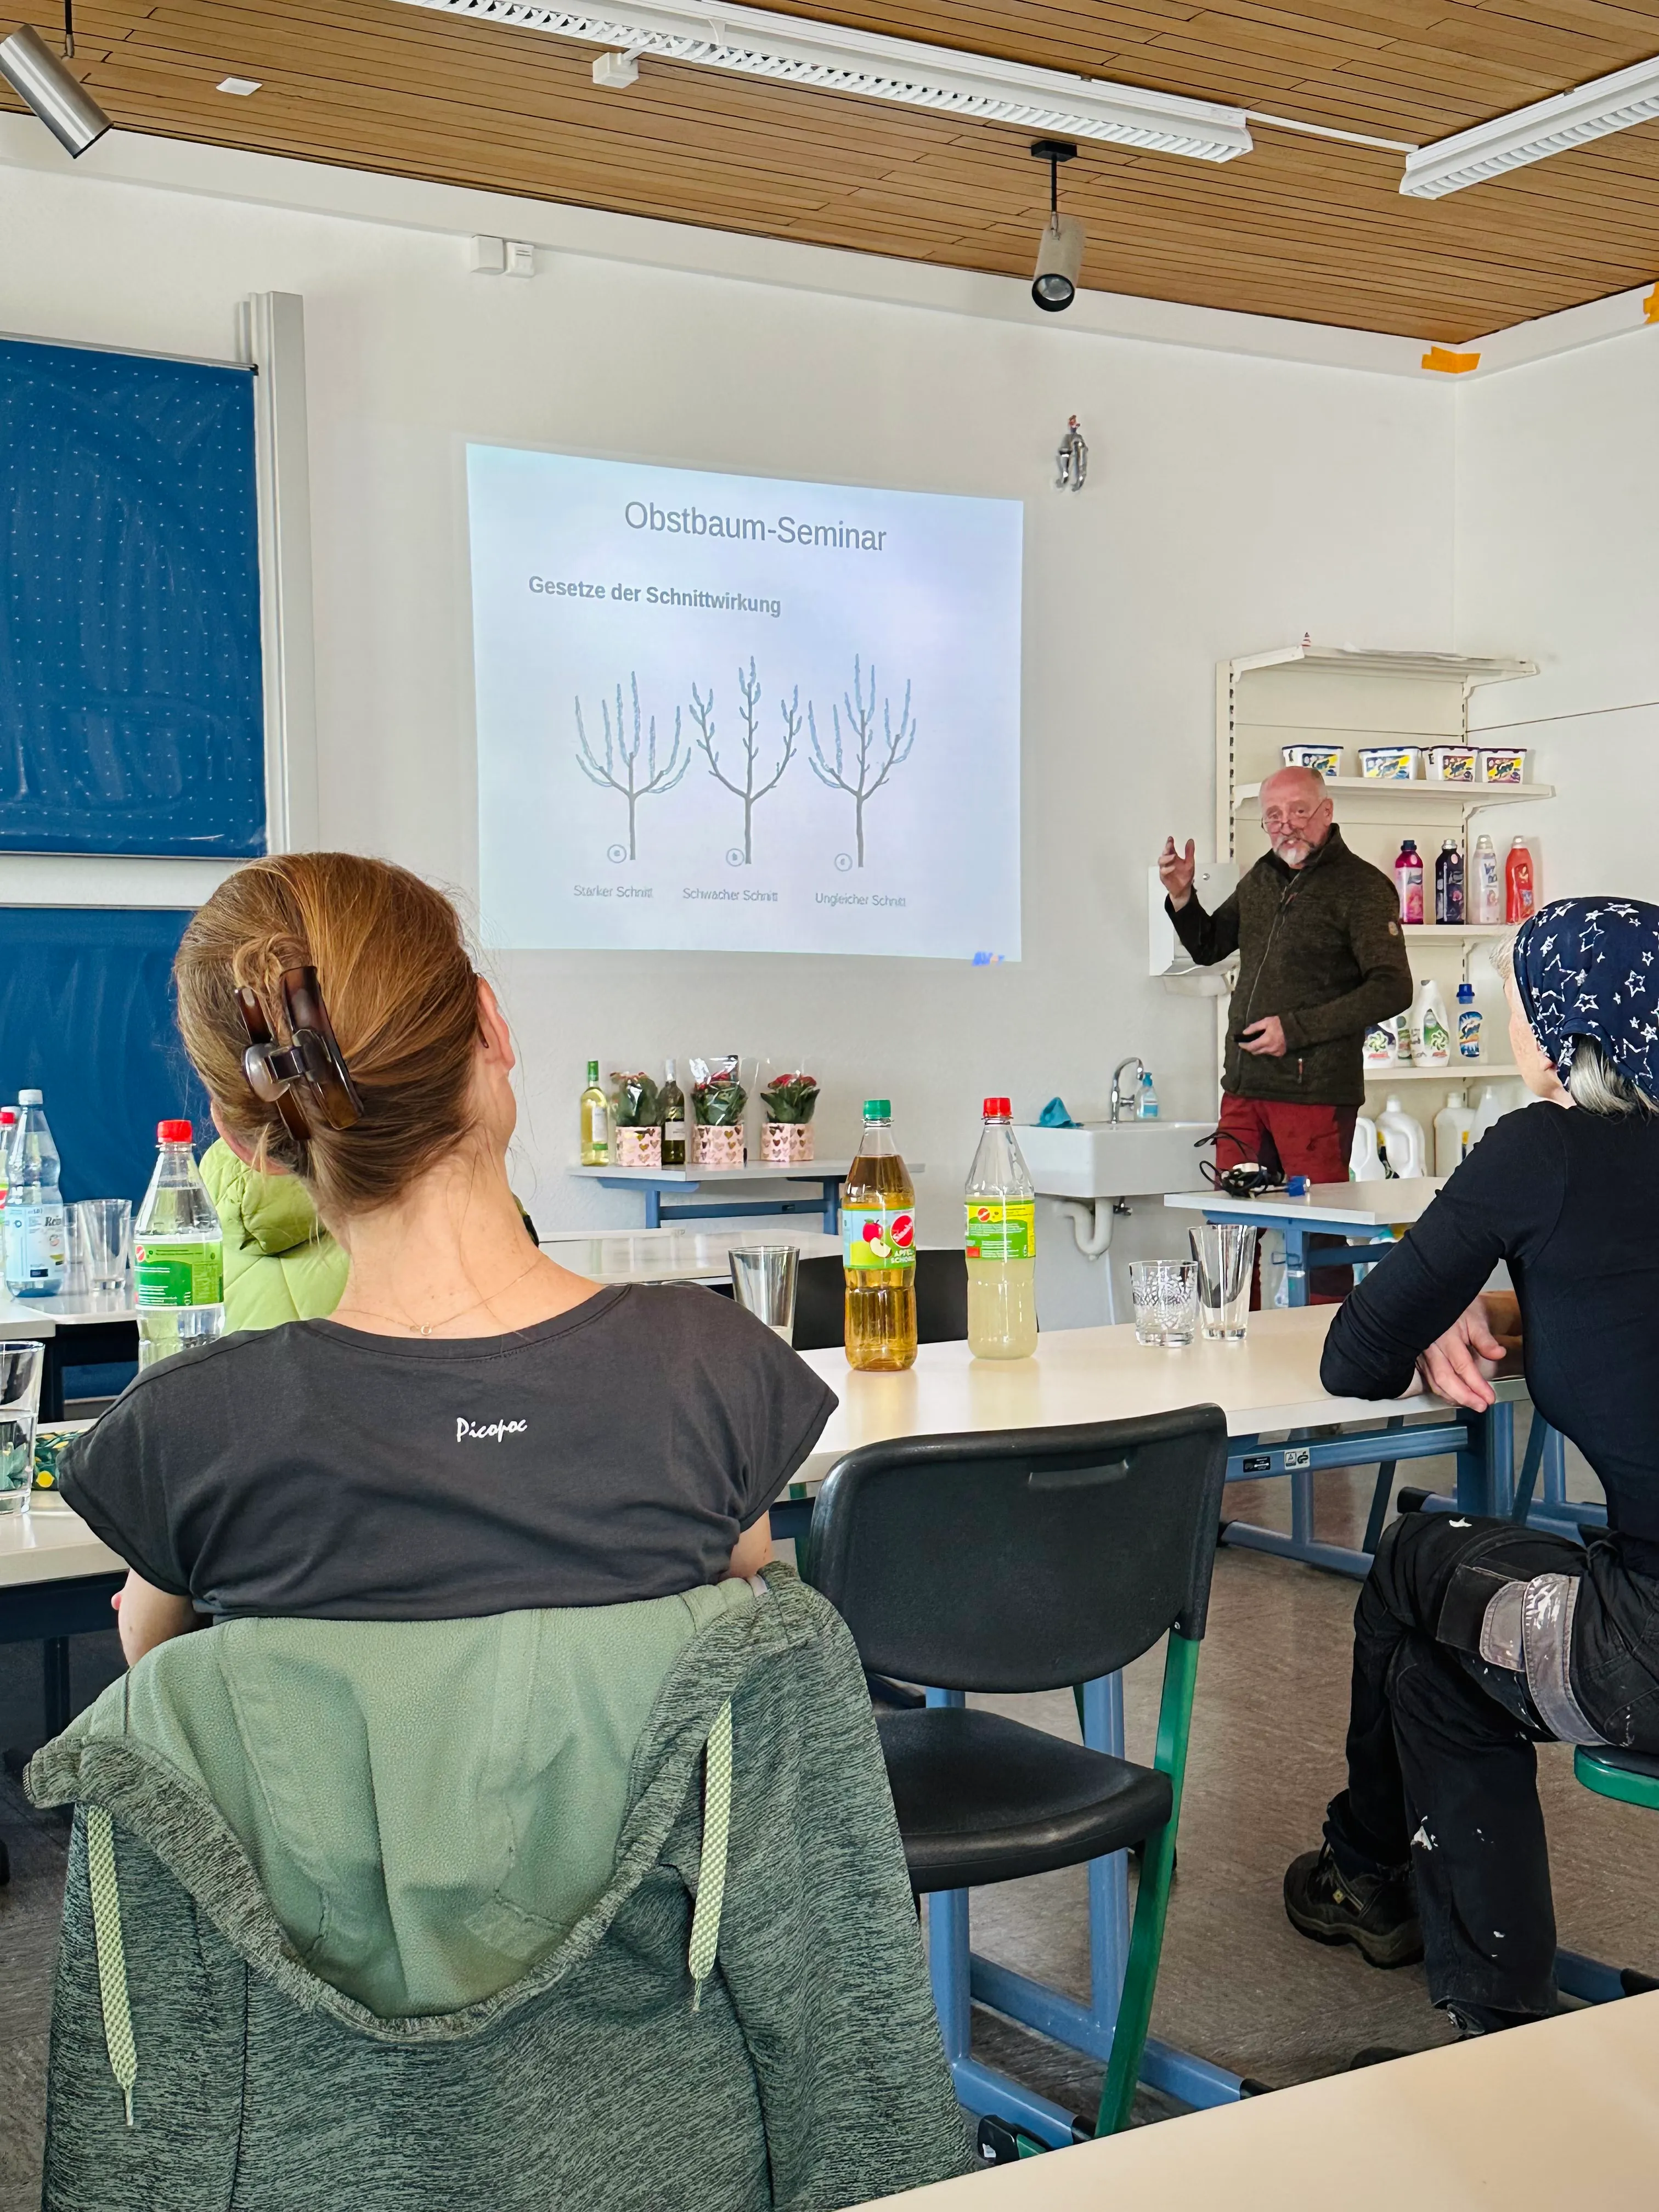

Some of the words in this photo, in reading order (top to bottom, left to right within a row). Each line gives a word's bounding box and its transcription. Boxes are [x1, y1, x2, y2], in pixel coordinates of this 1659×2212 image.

[625, 501, 887, 551] Obstbaum-Seminar
[528, 576, 606, 599] Gesetze
[611, 583, 641, 602] der
[646, 586, 781, 618] Schnittwirkung
[573, 884, 613, 897] Starker
[682, 887, 740, 900] Schwacher
[815, 893, 868, 907] Ungleicher
